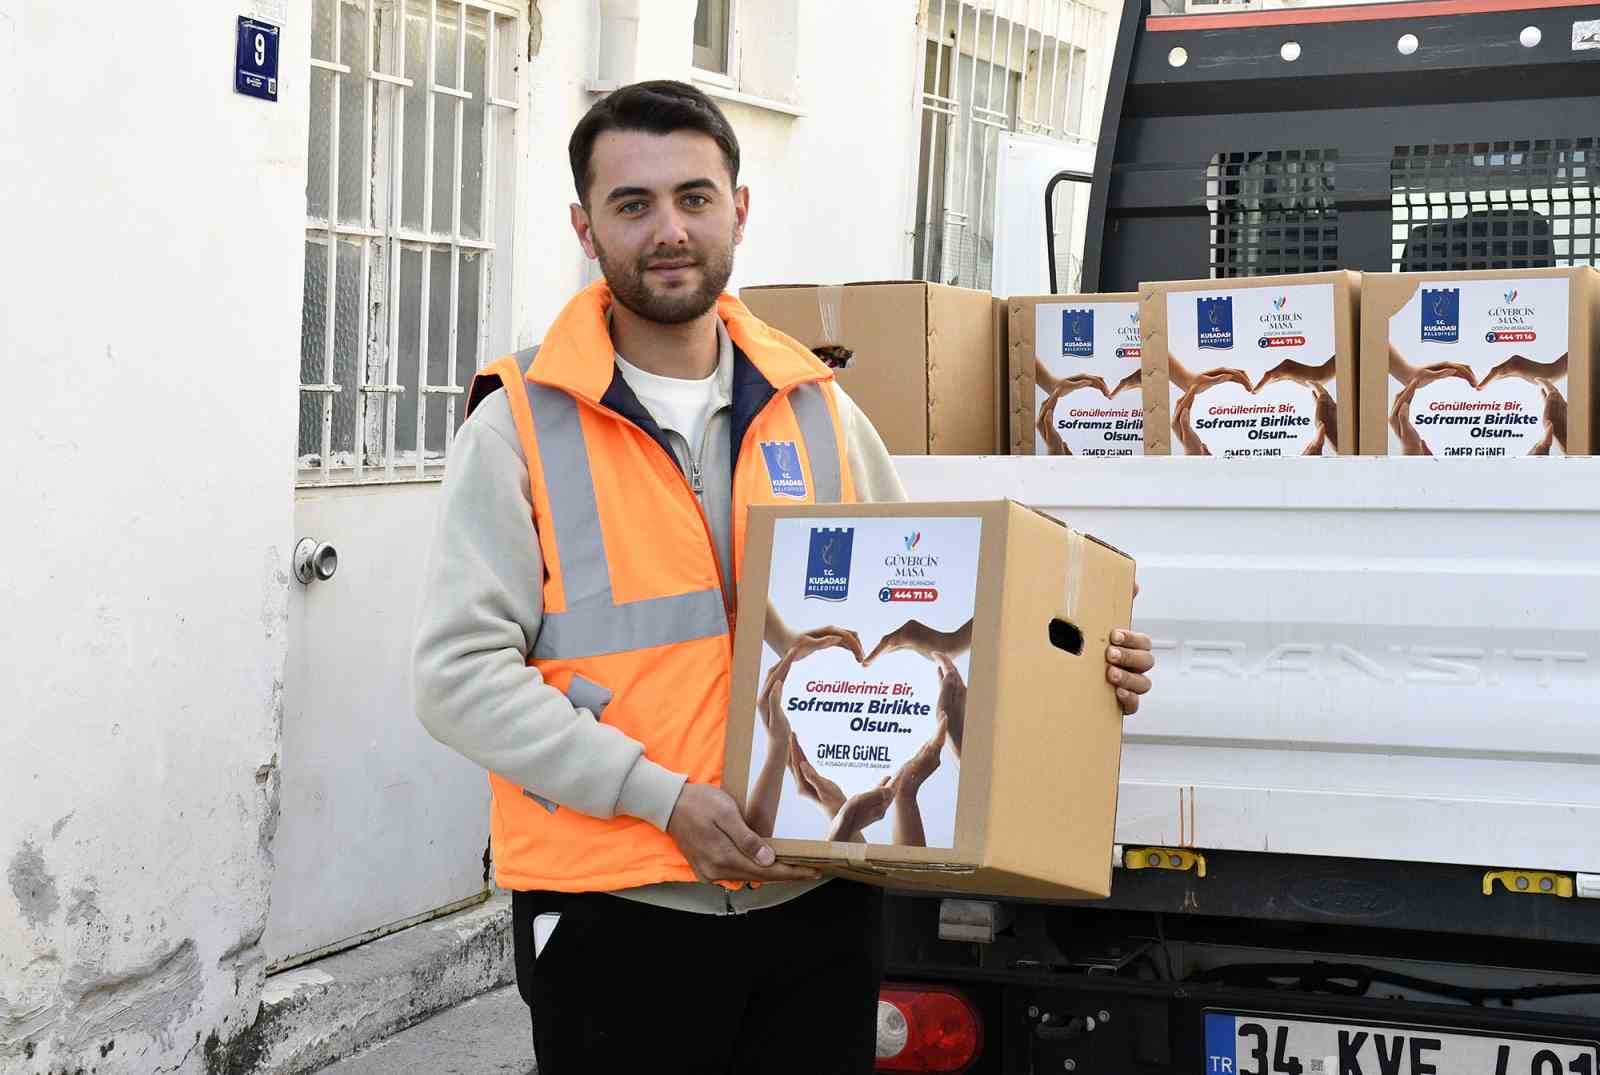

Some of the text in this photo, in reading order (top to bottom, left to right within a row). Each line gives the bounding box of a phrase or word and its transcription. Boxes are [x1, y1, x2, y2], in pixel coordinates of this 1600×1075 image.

[255, 33, 265, 66] 9
[1070, 408, 1130, 418] Gönüllerimiz
[1208, 402, 1297, 416] Gönüllerimiz Bir,
[1429, 401, 1523, 412] Gönüllerimiz Bir,
[1058, 419, 1112, 430] Soframız
[1196, 415, 1311, 430] Soframız Birlikte
[1415, 413, 1538, 425] Soframız Birlikte
[1247, 429, 1298, 440] Olsun...
[1470, 427, 1524, 438] Olsun...
[884, 553, 939, 567] GÜVERCİN
[895, 567, 925, 577] MASA
[894, 591, 934, 600] 444 71 14
[806, 680, 914, 697] Gönüllerimiz Bir,
[787, 697, 930, 716] Soframız Birlikte
[850, 717, 912, 734] Olsun...
[852, 745, 892, 762] GÜNEL
[1238, 1023, 1303, 1075] 34
[1210, 1055, 1233, 1073] TR
